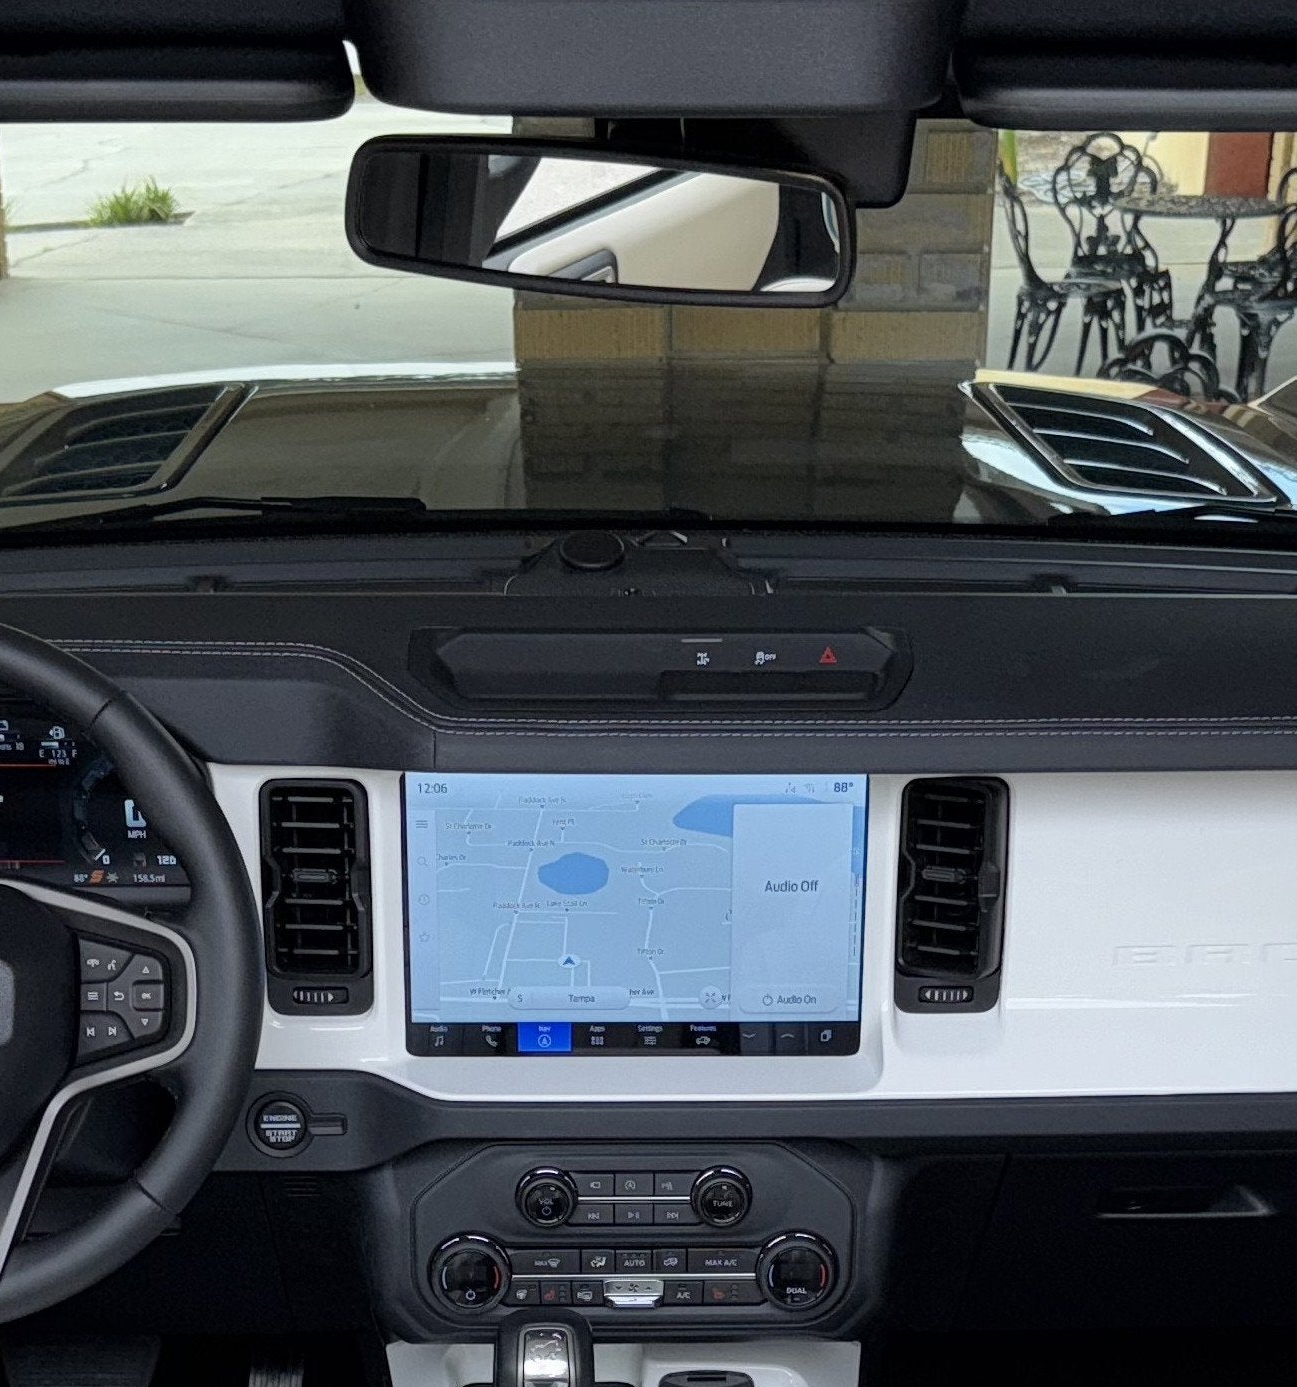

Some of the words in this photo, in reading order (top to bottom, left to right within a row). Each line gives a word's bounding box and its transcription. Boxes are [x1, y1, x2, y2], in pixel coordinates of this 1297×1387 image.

[417, 783, 448, 794] 12:06
[833, 782, 853, 793] 88°
[127, 830, 147, 838] MPH
[764, 880, 798, 892] Audio
[800, 880, 819, 892] Off
[517, 994, 523, 1002] S
[568, 995, 595, 1003] Tampa
[777, 995, 802, 1004] Audio
[803, 995, 816, 1004] On
[623, 1259, 645, 1267] AUTO
